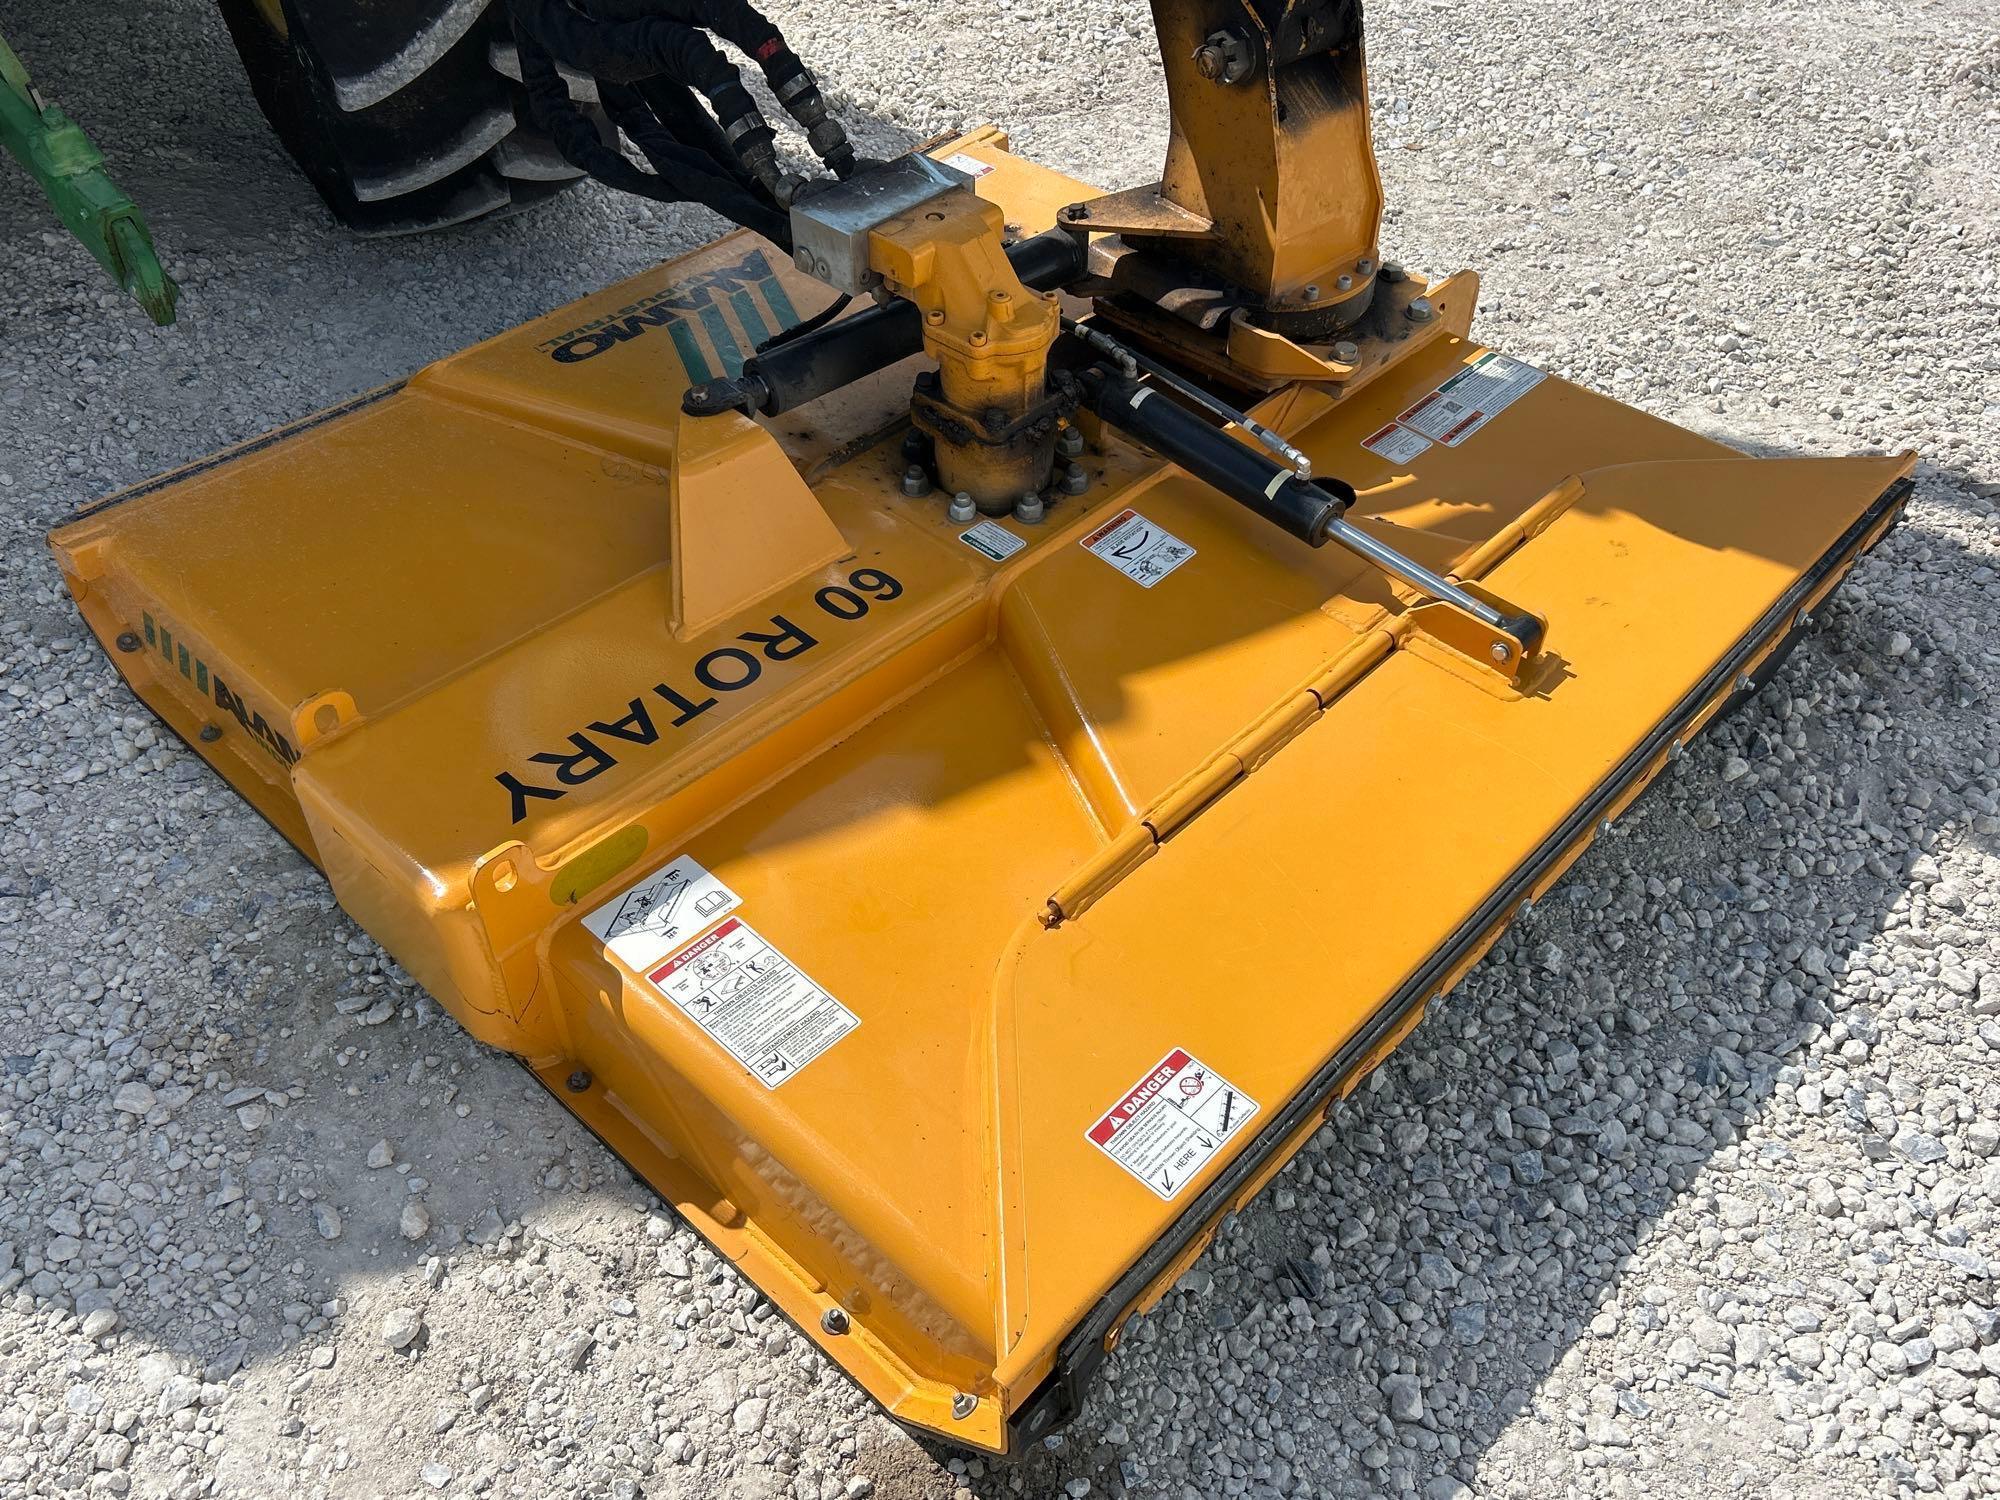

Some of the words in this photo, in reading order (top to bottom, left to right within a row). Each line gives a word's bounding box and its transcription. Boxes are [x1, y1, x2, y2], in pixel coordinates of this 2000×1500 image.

[551, 249, 774, 363] ALAMO
[1095, 515, 1128, 537] WARNING
[815, 568, 903, 620] 60
[213, 674, 301, 768] ALAM
[494, 614, 819, 825] ROTARY
[680, 933, 720, 961] DANGER
[713, 999, 735, 1015] THROWN
[734, 983, 757, 1000] OBJECTS
[756, 969, 777, 984] HAZARD
[760, 1024, 801, 1054] ENTANGLEMENT
[799, 1009, 820, 1026] HAZARD
[1122, 1065, 1176, 1115] DANGER
[1109, 1128, 1127, 1144] THROWN
[1125, 1114, 1141, 1129] OBJECT
[1139, 1100, 1156, 1116] HAZARD
[1172, 1148, 1197, 1170] HERE
